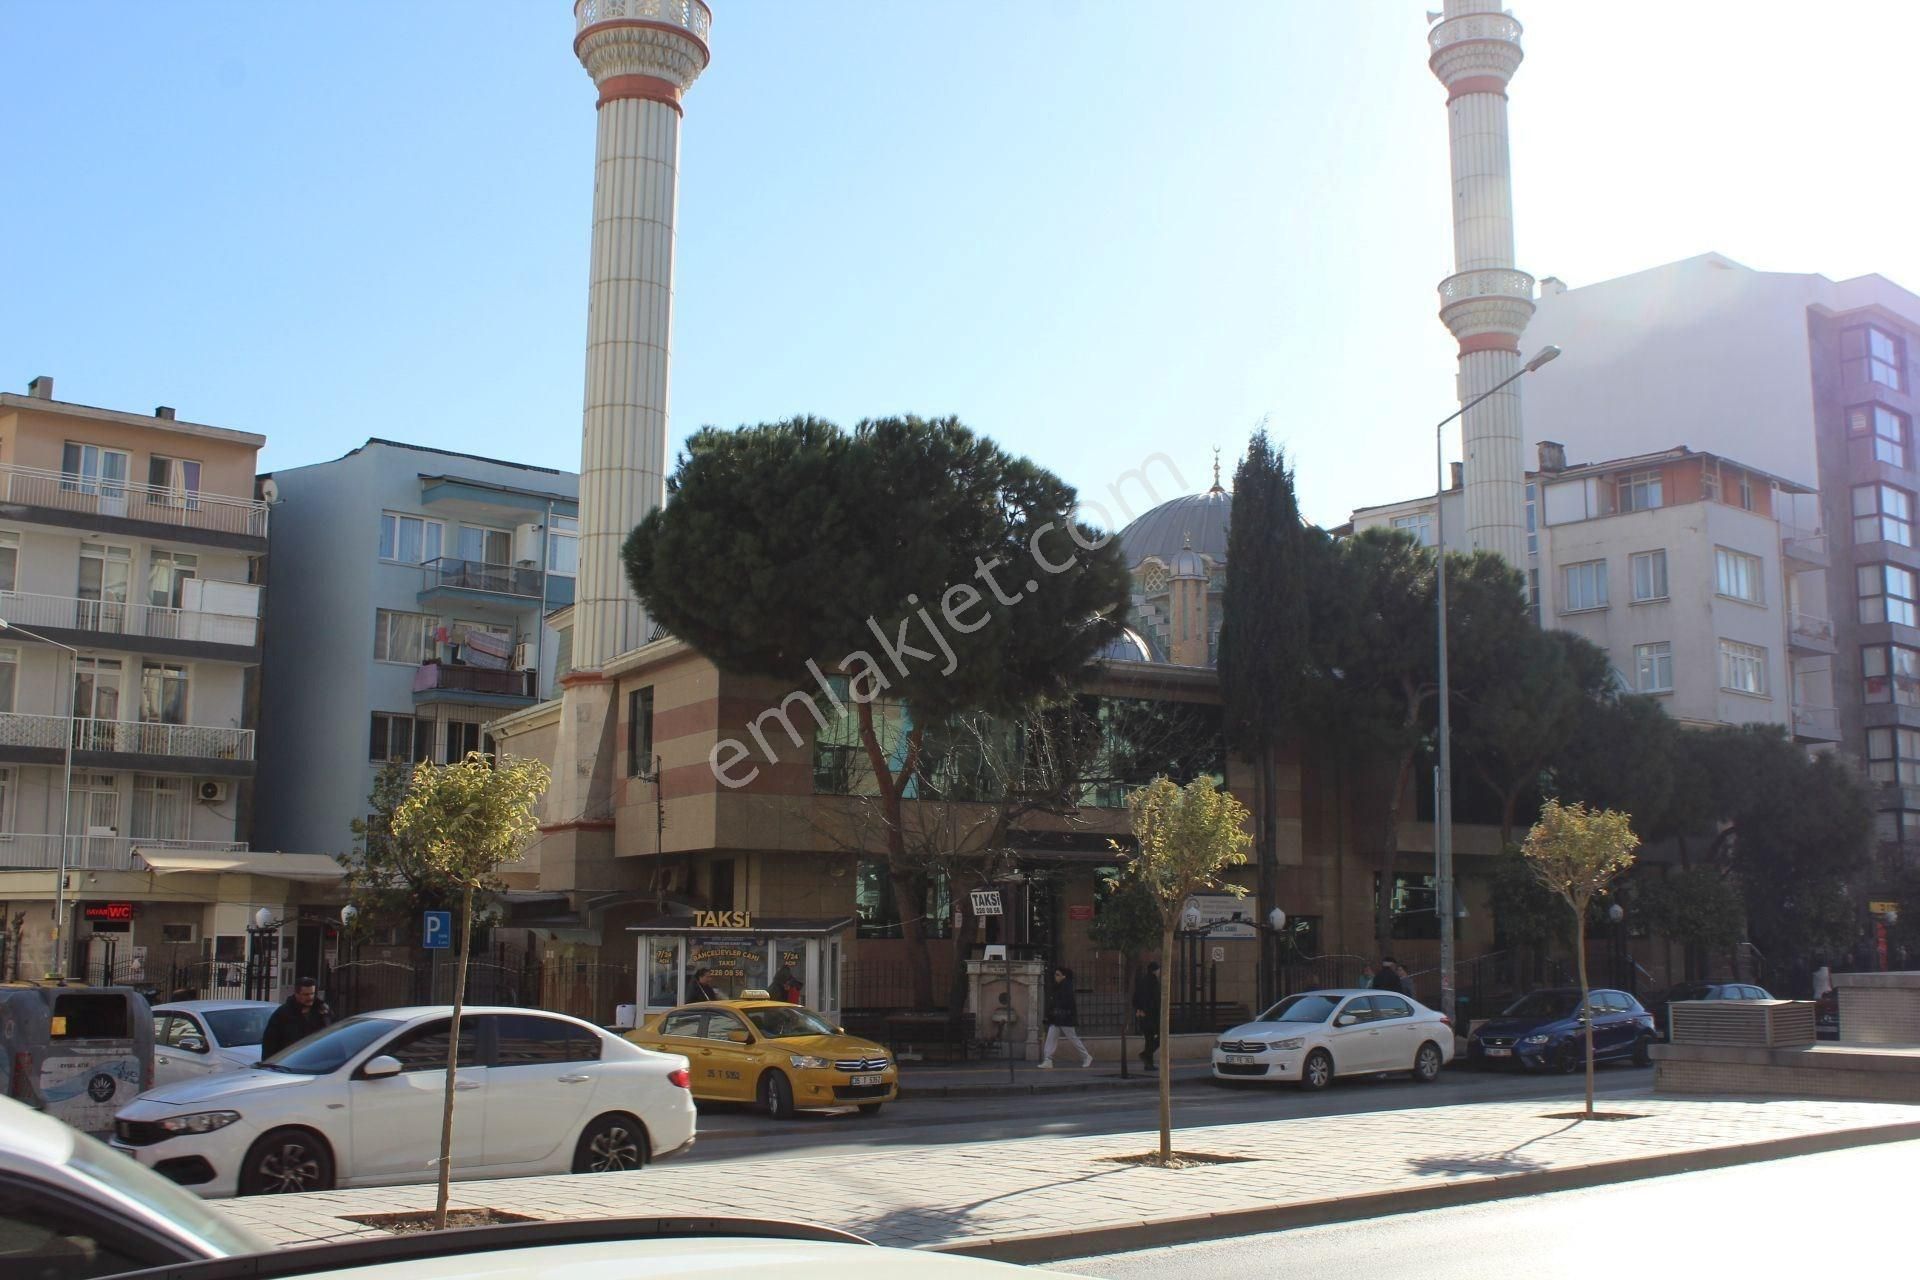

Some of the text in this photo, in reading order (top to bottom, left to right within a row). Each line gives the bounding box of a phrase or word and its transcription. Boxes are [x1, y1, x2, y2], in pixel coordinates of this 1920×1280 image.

[109, 907, 130, 917] WC
[693, 911, 750, 928] TAKSİ
[427, 916, 441, 944] P
[656, 950, 672, 959] 7/24
[783, 951, 799, 960] 7/24
[710, 969, 723, 977] 228
[718, 1069, 723, 1079] T
